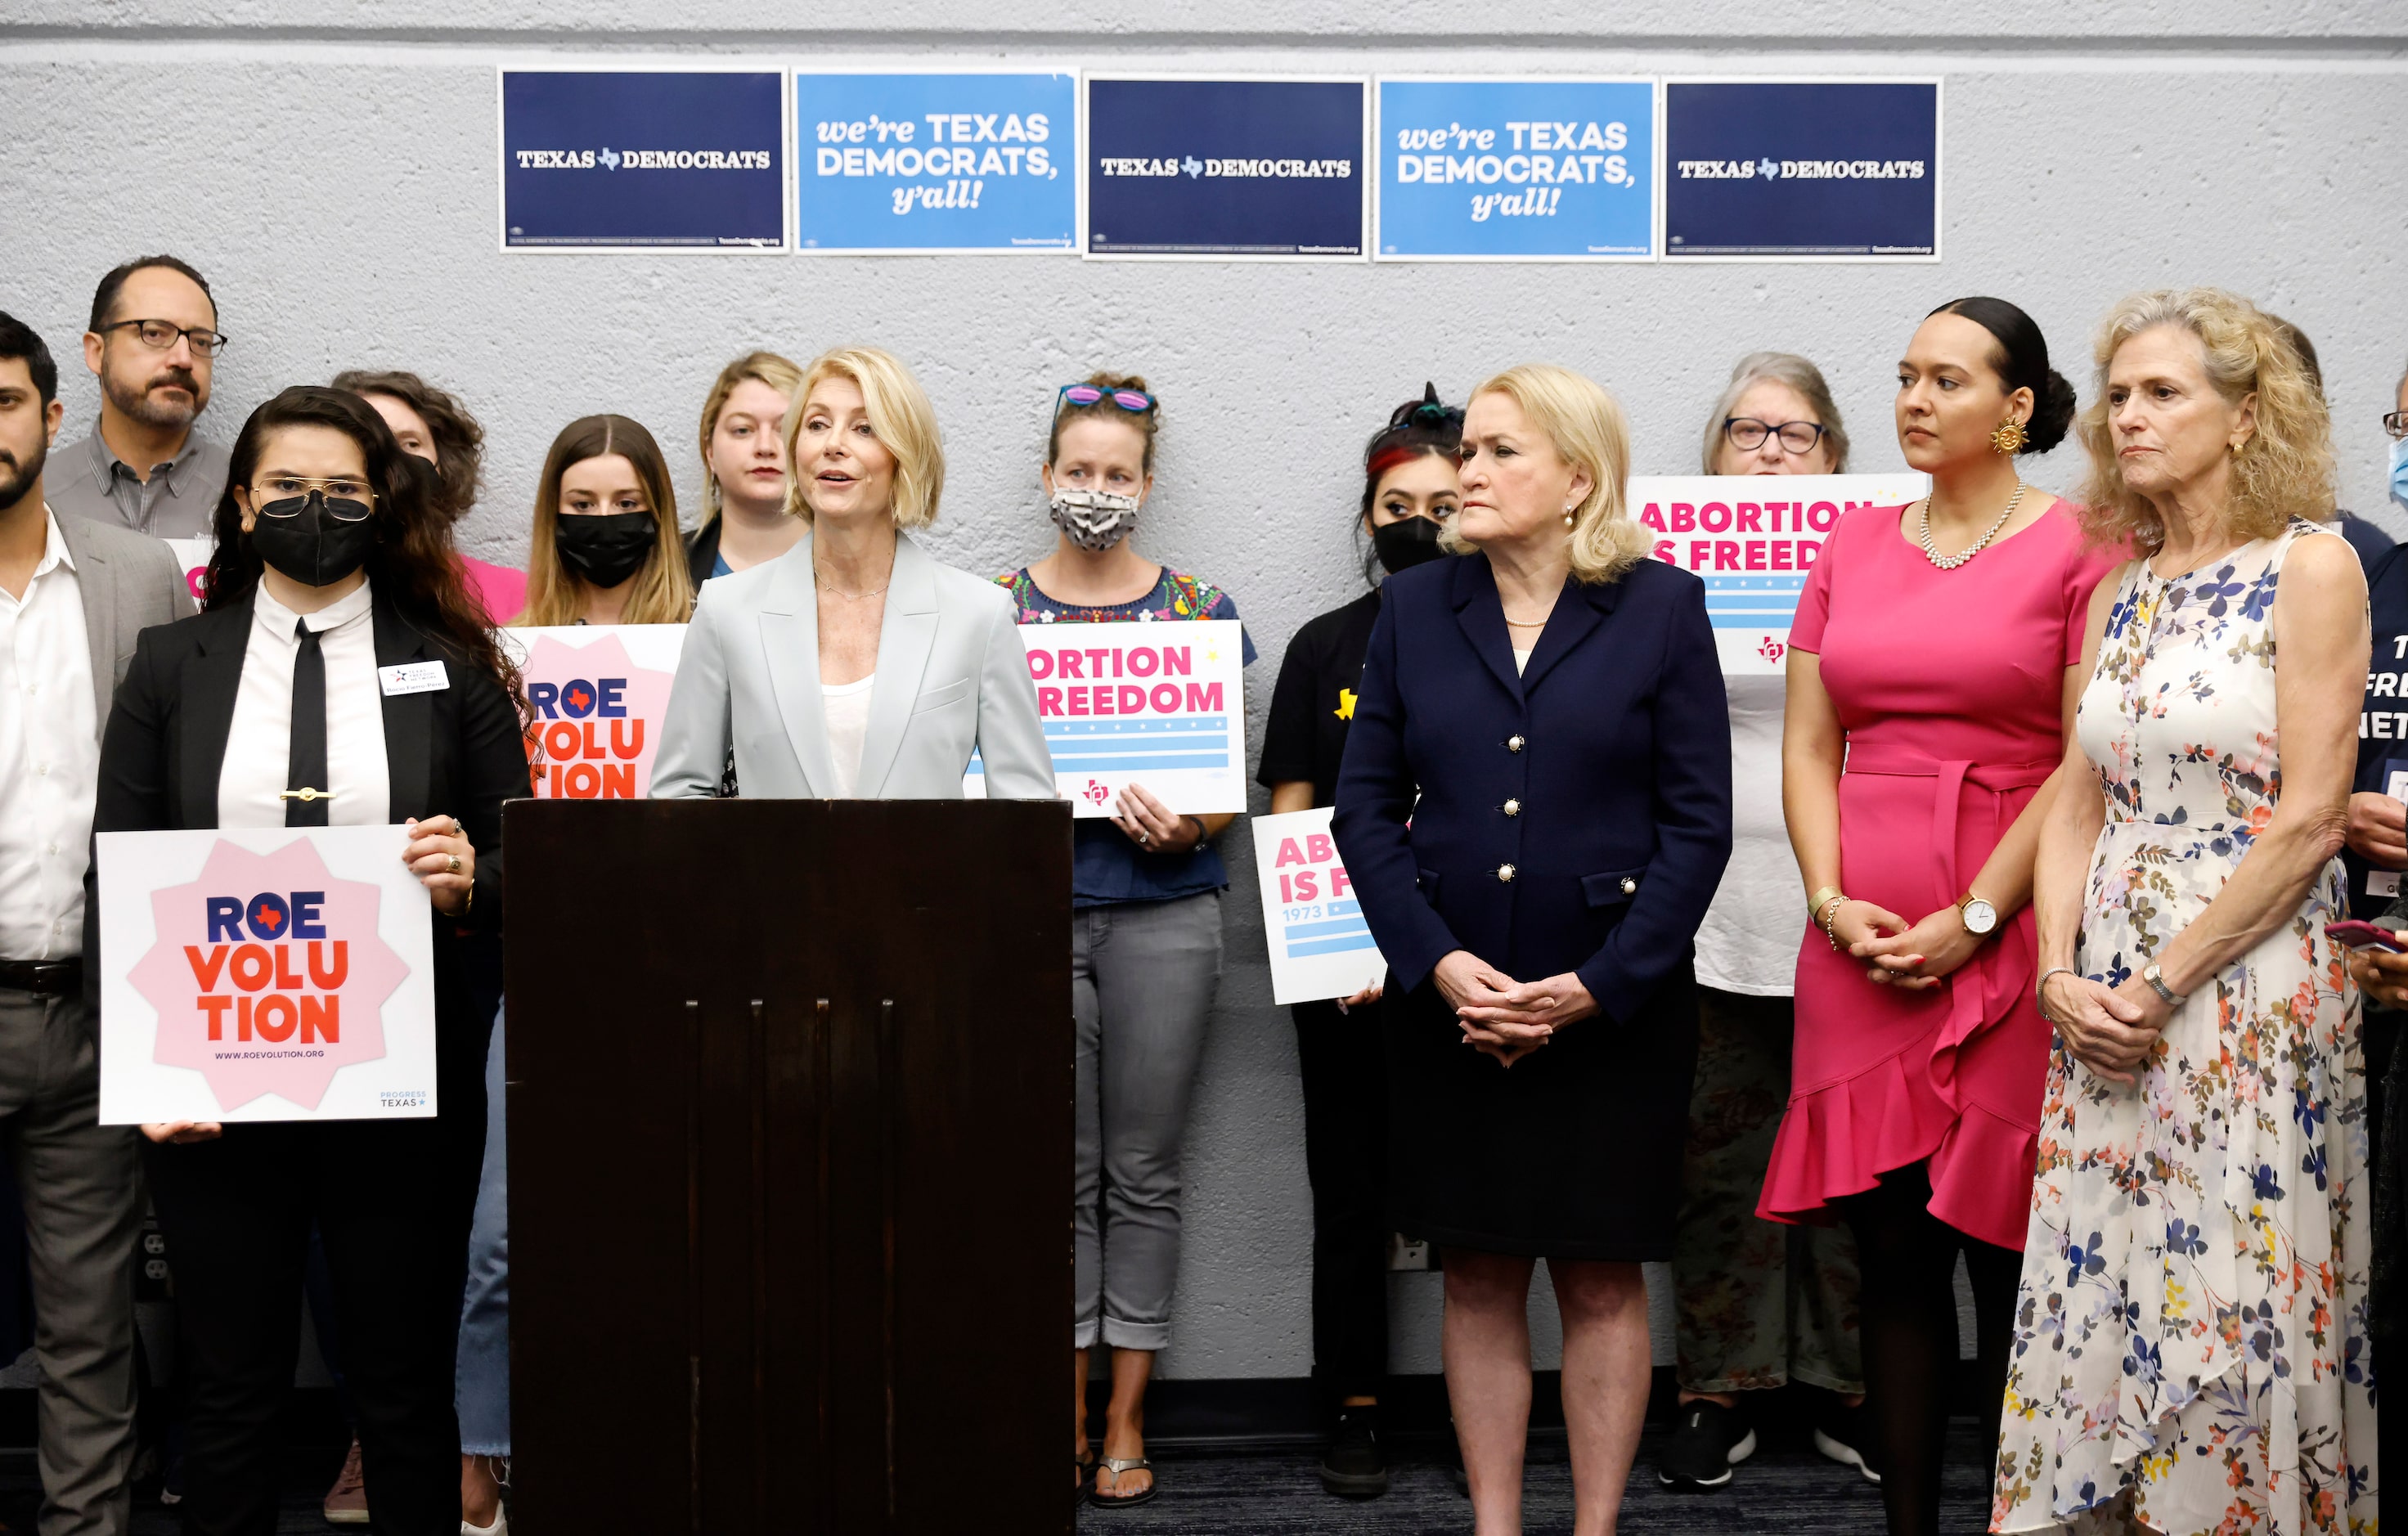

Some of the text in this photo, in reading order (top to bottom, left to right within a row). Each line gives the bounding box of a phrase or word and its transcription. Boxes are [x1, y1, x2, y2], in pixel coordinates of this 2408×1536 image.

[925, 113, 1049, 142] TEXAS
[1505, 121, 1628, 150] TEXAS
[517, 150, 770, 169] TEXAS DEMOCRATS
[816, 146, 1058, 182] DEMOCRATS,
[1101, 158, 1351, 177] TEXAS DEMOCRATS
[1398, 154, 1635, 189] DEMOCRATS,
[1678, 160, 1925, 179] TEXAS DEMOCRATS
[1638, 501, 1872, 532] ABORTIO
[528, 678, 627, 720] ROE
[1275, 833, 1339, 869] AB
[1279, 871, 1319, 903] IS
[206, 891, 327, 943] ROE
[1283, 905, 1323, 923] 1973
[182, 940, 348, 993] VOLU
[196, 994, 340, 1044] TION
[214, 1049, 325, 1060] WWW.ROEVOLUTION.ORG
[381, 1098, 417, 1107] TEXAS
